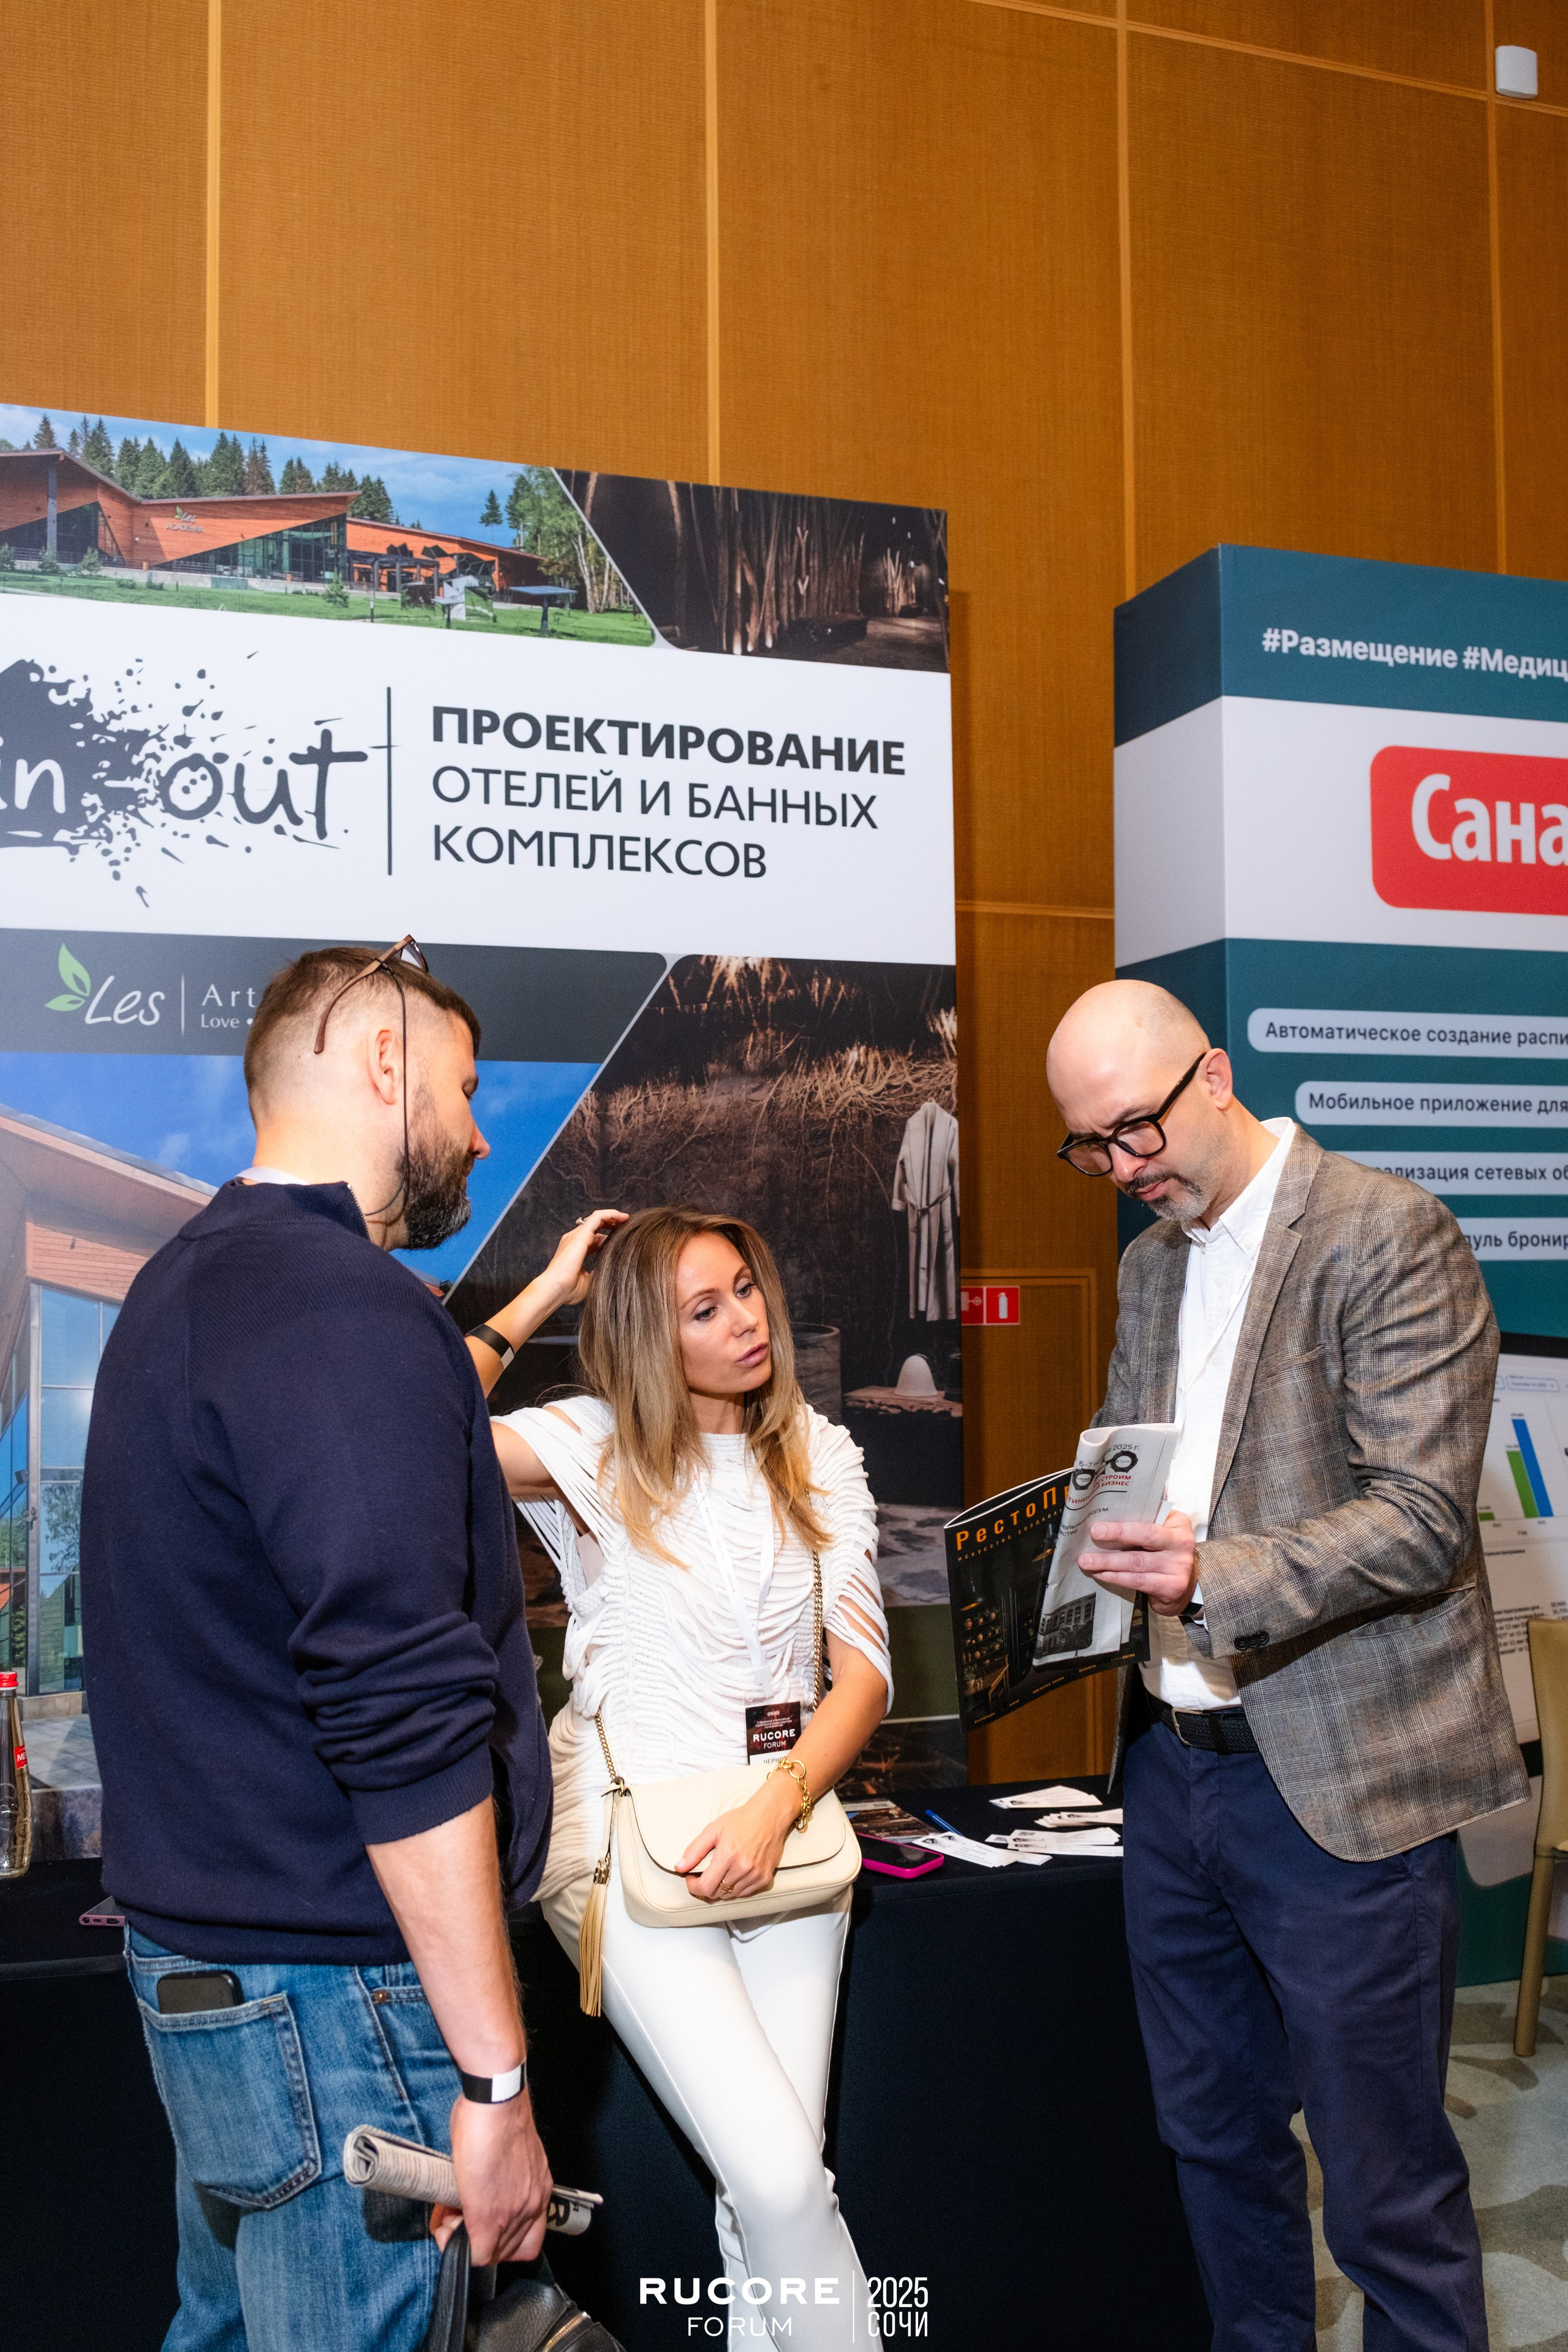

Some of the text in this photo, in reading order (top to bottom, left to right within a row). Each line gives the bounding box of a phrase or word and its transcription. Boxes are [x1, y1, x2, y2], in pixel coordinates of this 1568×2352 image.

[1262, 628, 1568, 682] #Размещение #Медиц
[432, 706, 905, 775] ПРОЕКТИРОВАНИЕ
[432, 766, 878, 829] ОТЕЛЕЙ И БАННЫХ
[1411, 773, 1568, 866] Сана
[434, 824, 766, 878] КОМПЛЕКСОВ
[85, 974, 165, 1027] Les
[202, 984, 256, 1008] Art
[201, 1014, 239, 1028] Love
[1265, 1022, 1568, 1047] Автоматическое создание распи
[1310, 1093, 1568, 1115] Мобильное приложение для
[1474, 1167, 1547, 1180] сетевых
[753, 1728, 796, 1743] RUCORE
[763, 1740, 787, 1750] FORUM
